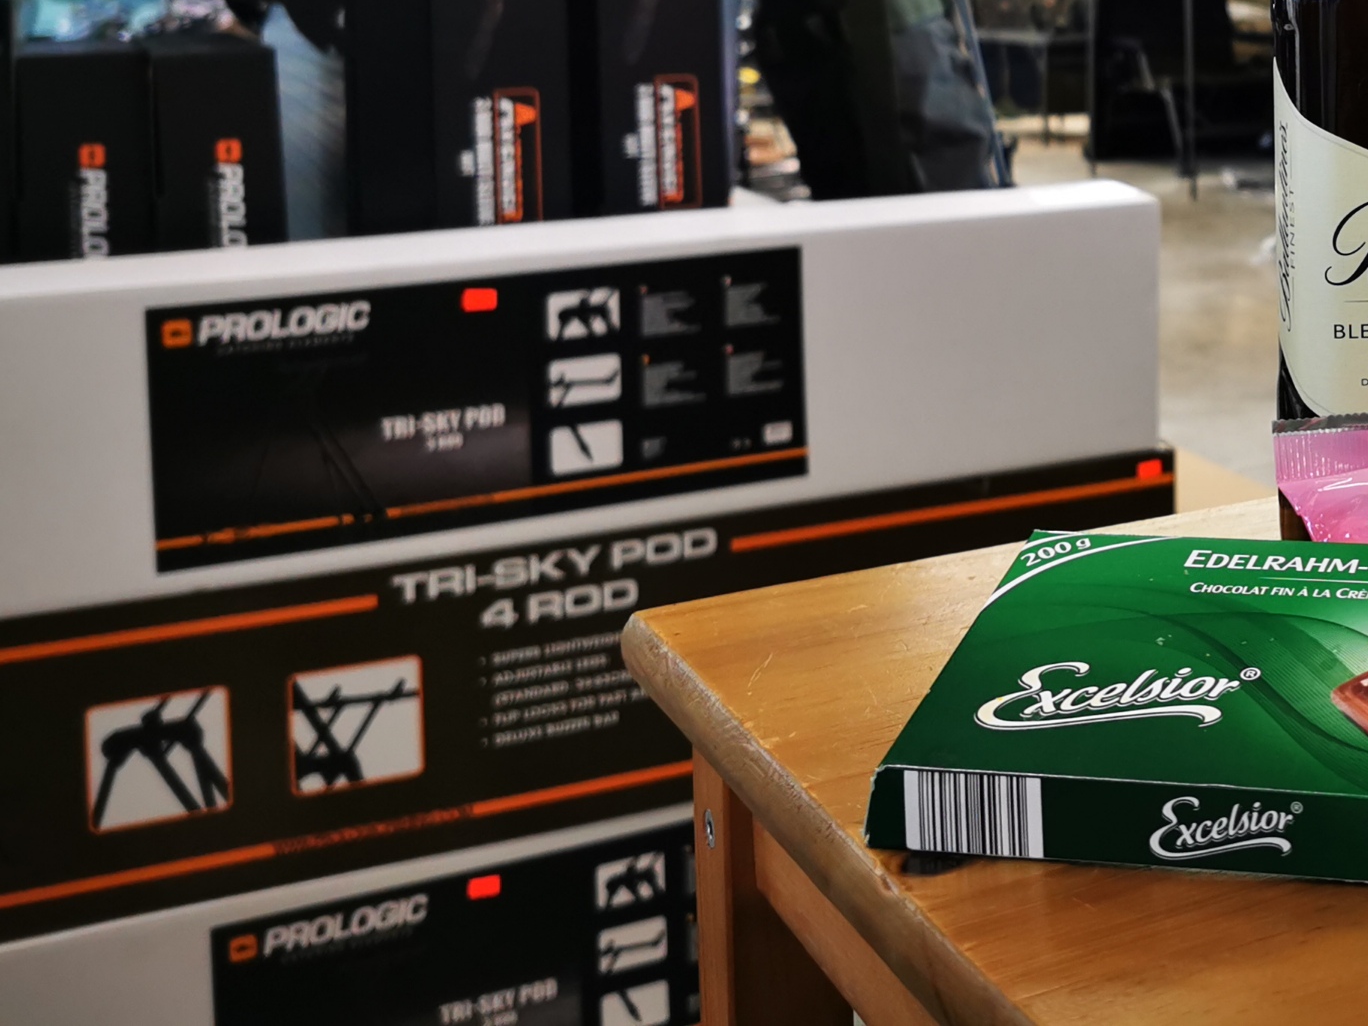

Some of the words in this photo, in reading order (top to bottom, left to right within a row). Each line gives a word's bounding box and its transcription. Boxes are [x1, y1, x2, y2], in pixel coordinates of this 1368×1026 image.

[80, 168, 110, 258] PROLO
[217, 163, 248, 248] PROLO
[198, 299, 372, 347] PROLOGIC
[391, 545, 602, 605] TRI-SKY
[610, 526, 718, 571] POD
[1020, 541, 1073, 568] 200
[1074, 535, 1092, 551] g
[480, 597, 519, 629] 4
[526, 577, 639, 624] ROD
[1189, 582, 1267, 598] CHOCOLAT
[1269, 585, 1295, 597] FIN
[1297, 583, 1310, 598] À
[1313, 587, 1332, 599] LA
[974, 660, 1247, 730] Excelsior
[1149, 796, 1297, 859] Excelsior
[263, 892, 430, 957] PROLOGIC
